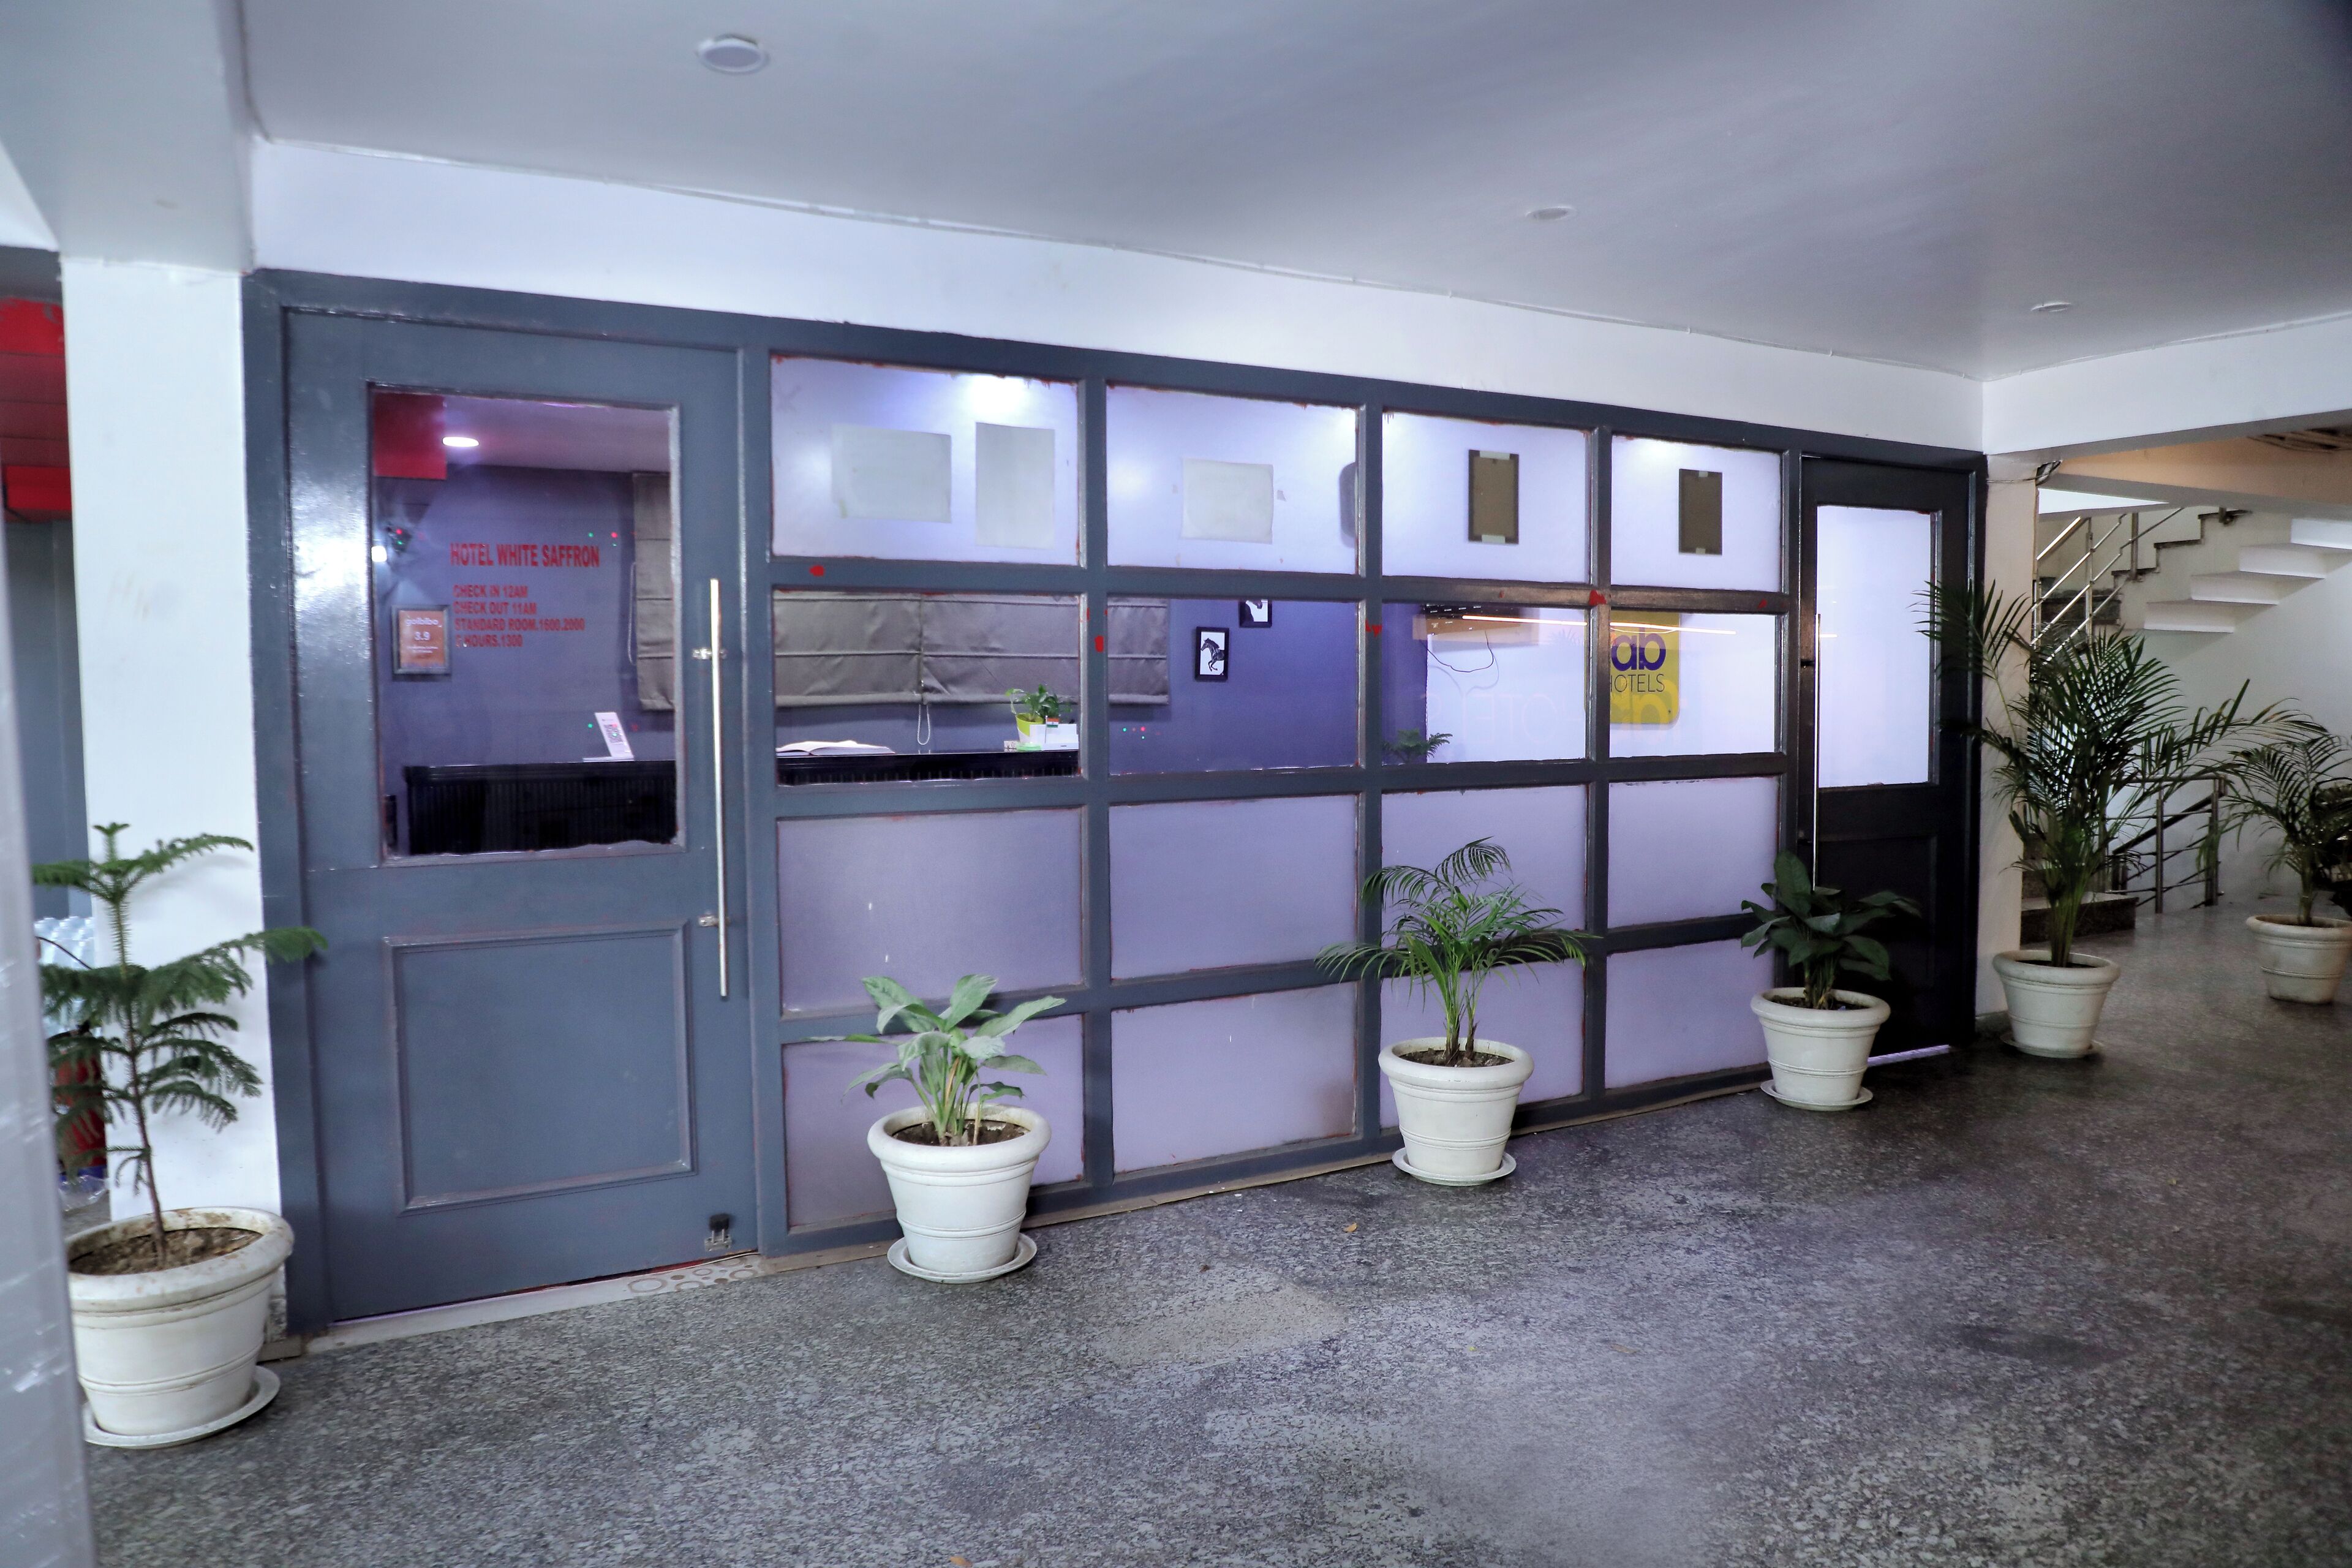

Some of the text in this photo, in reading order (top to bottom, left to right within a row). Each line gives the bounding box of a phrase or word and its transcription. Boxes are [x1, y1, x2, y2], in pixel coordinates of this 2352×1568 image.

[450, 543, 600, 567] HOTEL WHITE SAFFRON
[453, 585, 486, 598] CHECK
[490, 585, 500, 598] IN
[453, 601, 486, 614] CHECK
[489, 602, 509, 614] OUT
[454, 617, 505, 630] STANDARD
[1610, 627, 1666, 671] ab
